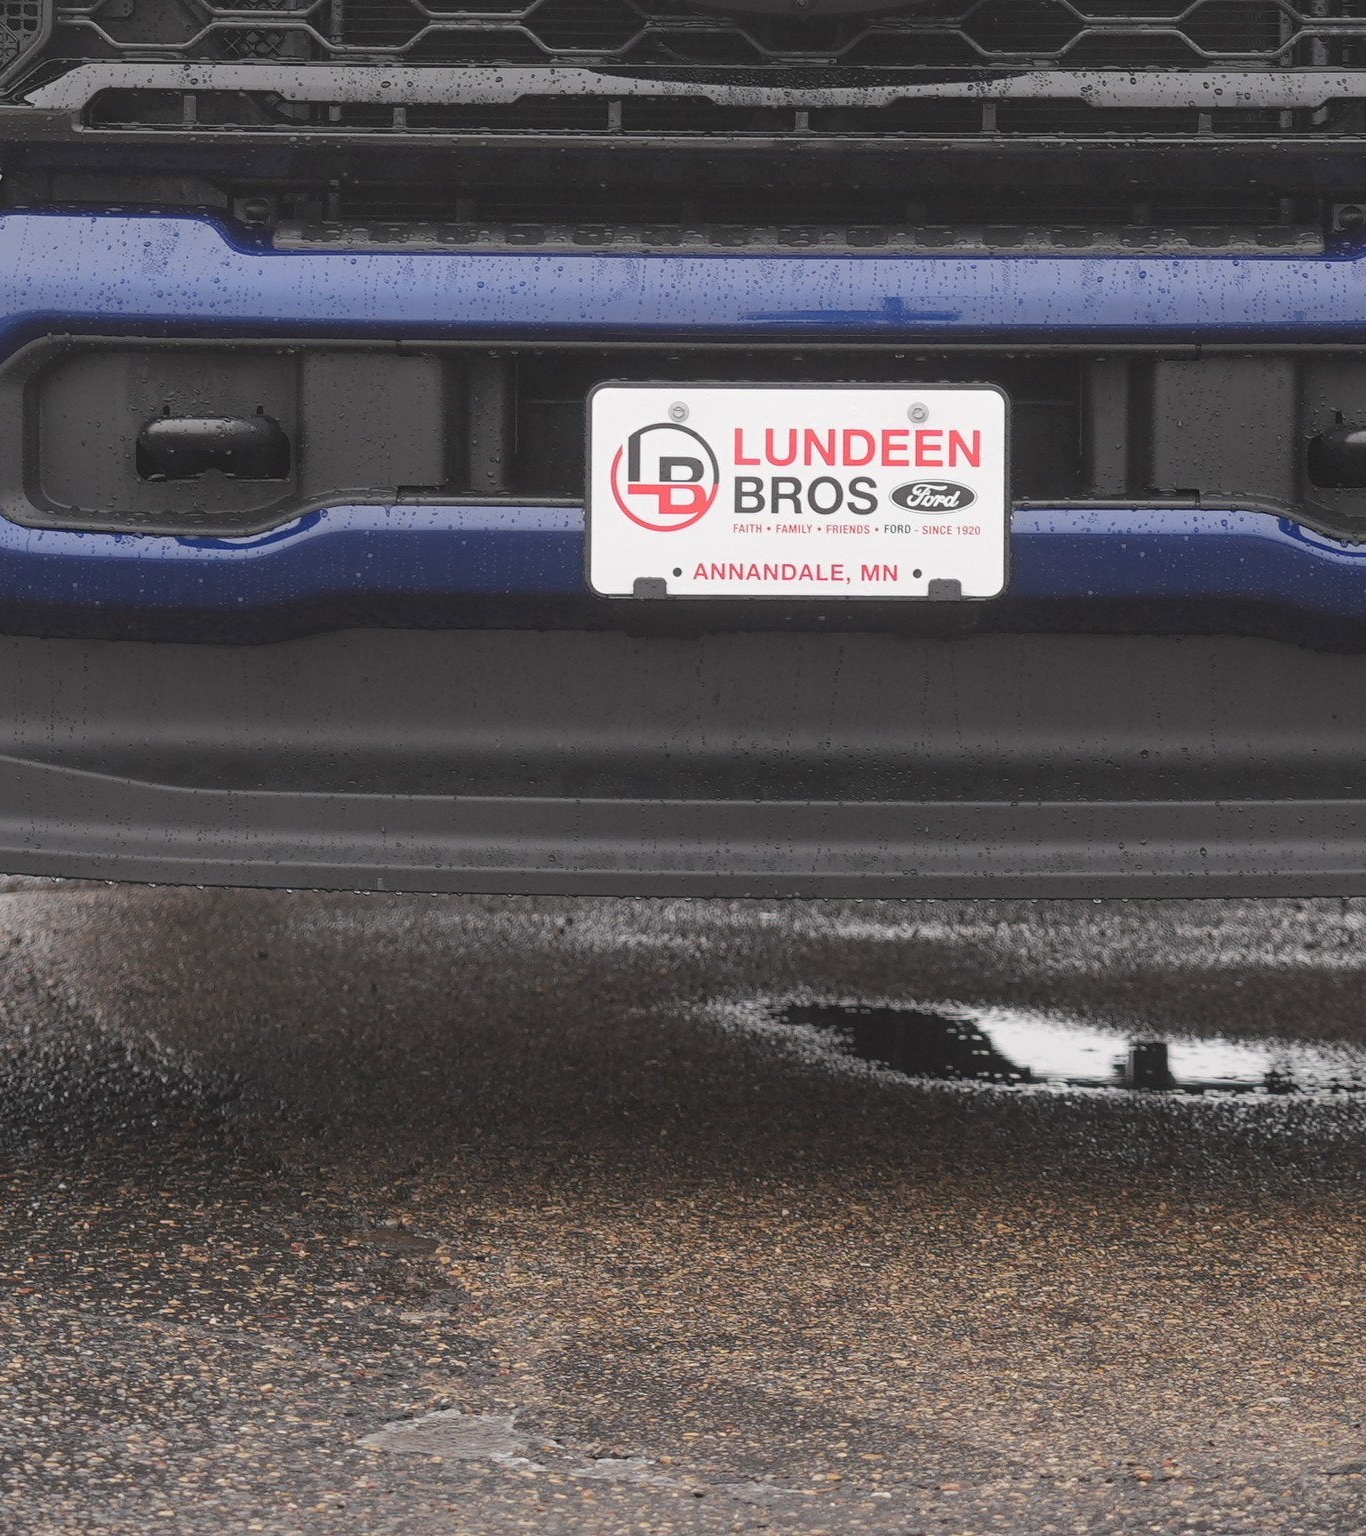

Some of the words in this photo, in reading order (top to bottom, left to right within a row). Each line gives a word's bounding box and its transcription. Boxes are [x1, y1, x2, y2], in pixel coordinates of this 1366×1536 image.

[734, 427, 981, 467] LUNDEEN
[734, 476, 878, 515] BROS
[905, 483, 961, 509] Ford
[732, 524, 762, 534] FAITH
[775, 524, 813, 534] FAMILY
[826, 525, 870, 535] FRIENDS
[884, 524, 911, 534] FORD
[922, 525, 953, 535] SINCE
[956, 526, 981, 536] 1920
[693, 563, 851, 584] ANNANDALE,
[861, 564, 898, 582] MN
